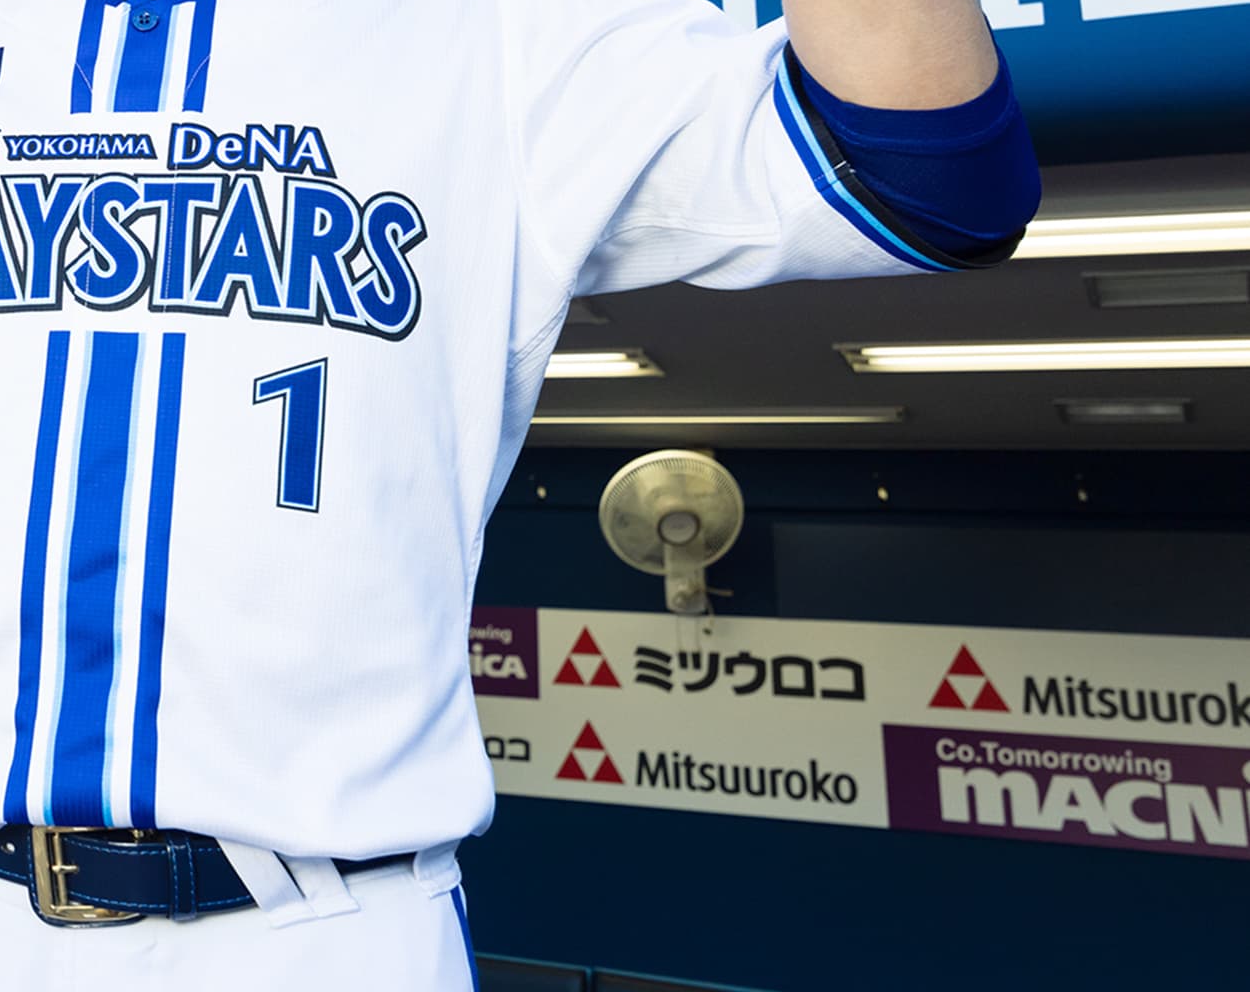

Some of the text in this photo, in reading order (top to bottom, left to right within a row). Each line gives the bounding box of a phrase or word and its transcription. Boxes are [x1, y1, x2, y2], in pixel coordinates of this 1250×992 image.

[3, 123, 337, 178] YOKOHAMA DeNA
[253, 357, 328, 513] 1
[635, 646, 865, 701] ミツウロコ
[635, 750, 858, 805] Mitsuuroko
[936, 738, 1172, 782] Co.Tomorrowing
